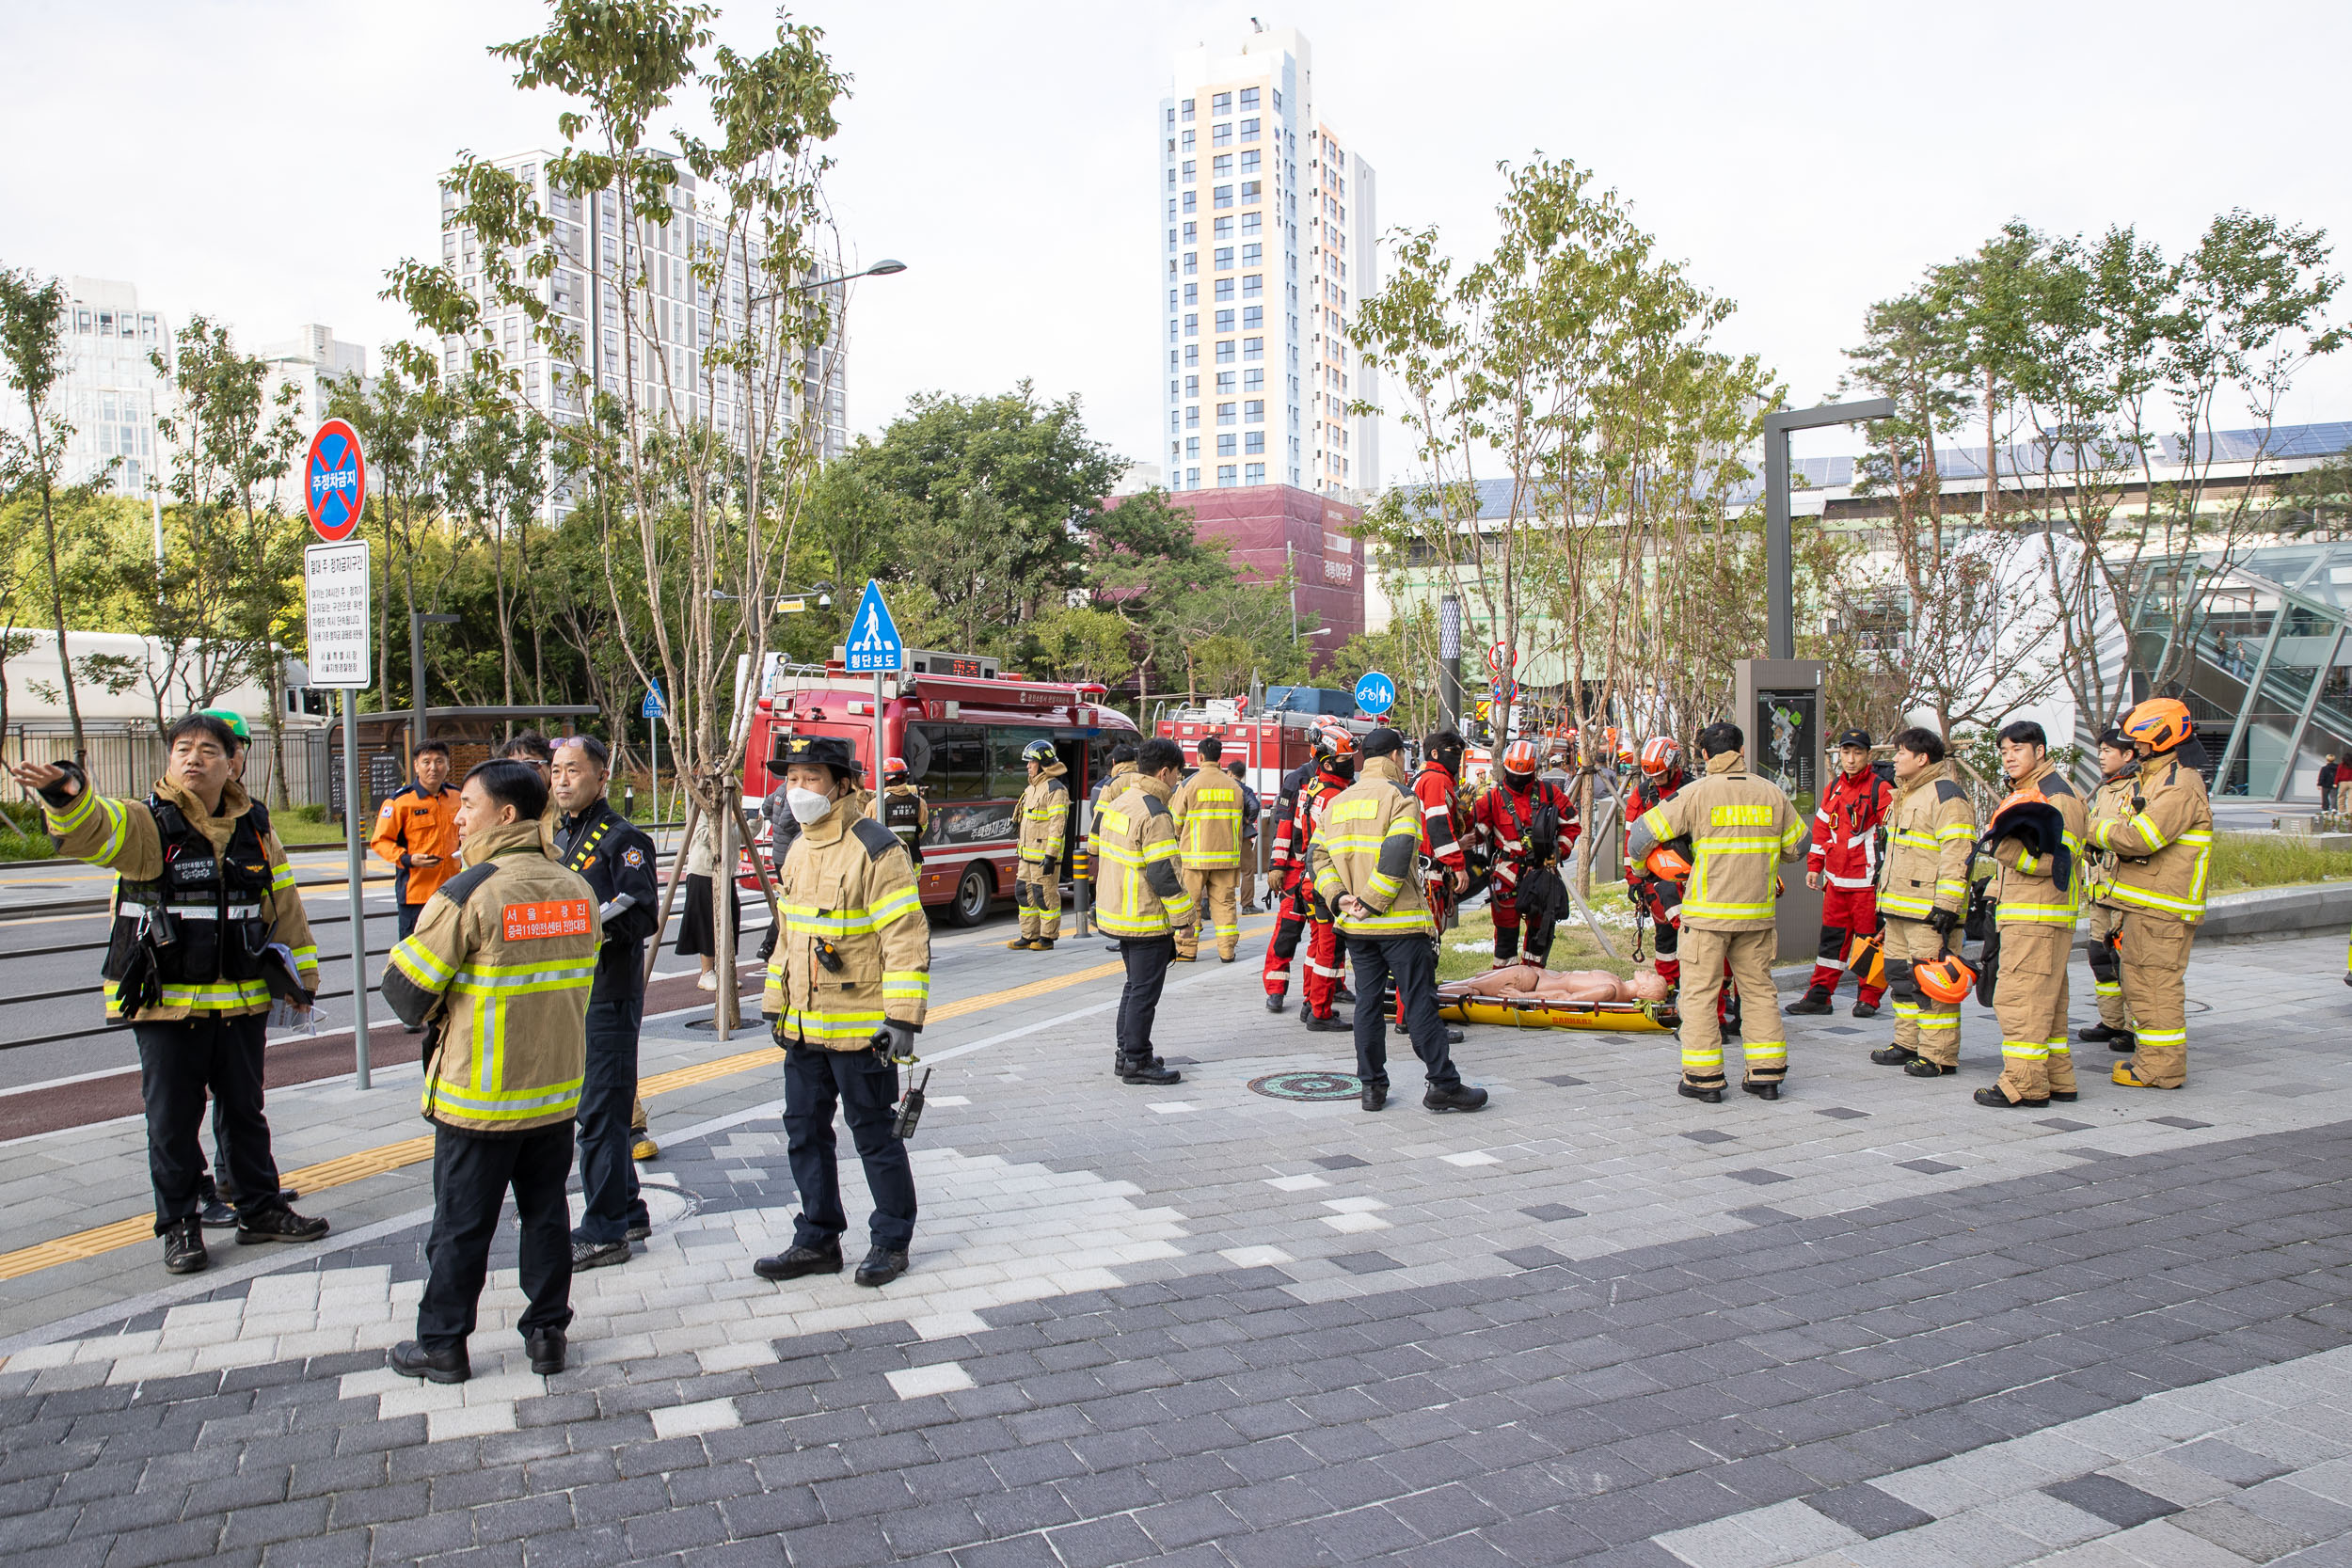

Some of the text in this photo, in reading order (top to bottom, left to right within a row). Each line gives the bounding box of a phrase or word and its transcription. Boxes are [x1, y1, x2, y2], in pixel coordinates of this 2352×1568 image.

[312, 469, 357, 492] 주정차금지
[312, 600, 363, 613] 금지되는 구간으로 위반
[850, 654, 896, 669] 횡단보도
